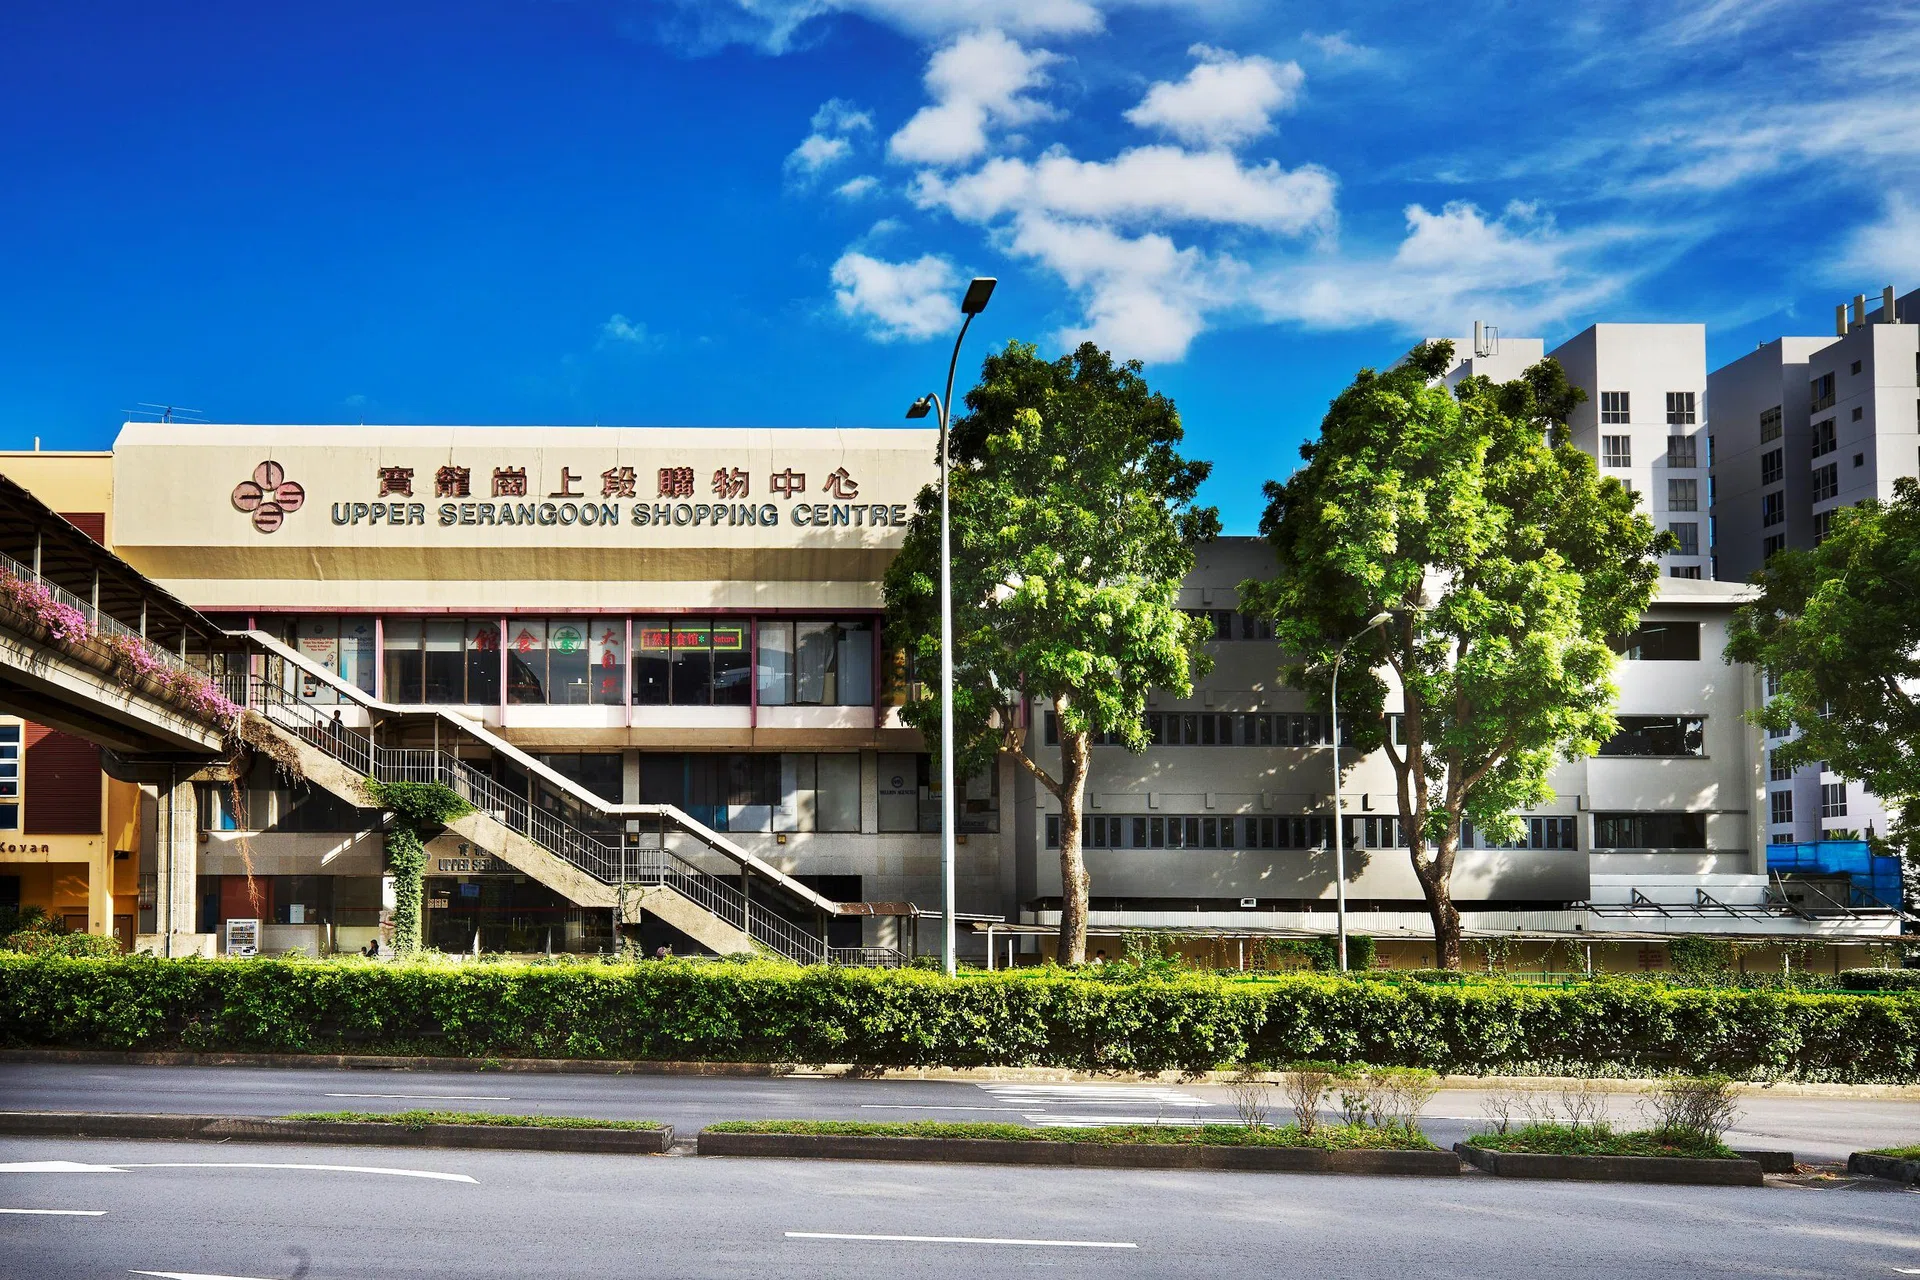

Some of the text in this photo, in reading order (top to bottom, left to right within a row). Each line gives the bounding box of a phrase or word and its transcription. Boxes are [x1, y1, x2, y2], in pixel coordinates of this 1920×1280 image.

[332, 502, 907, 526] UPPER SERANGOON SHOPPING CENTRE
[439, 858, 470, 872] UPPER
